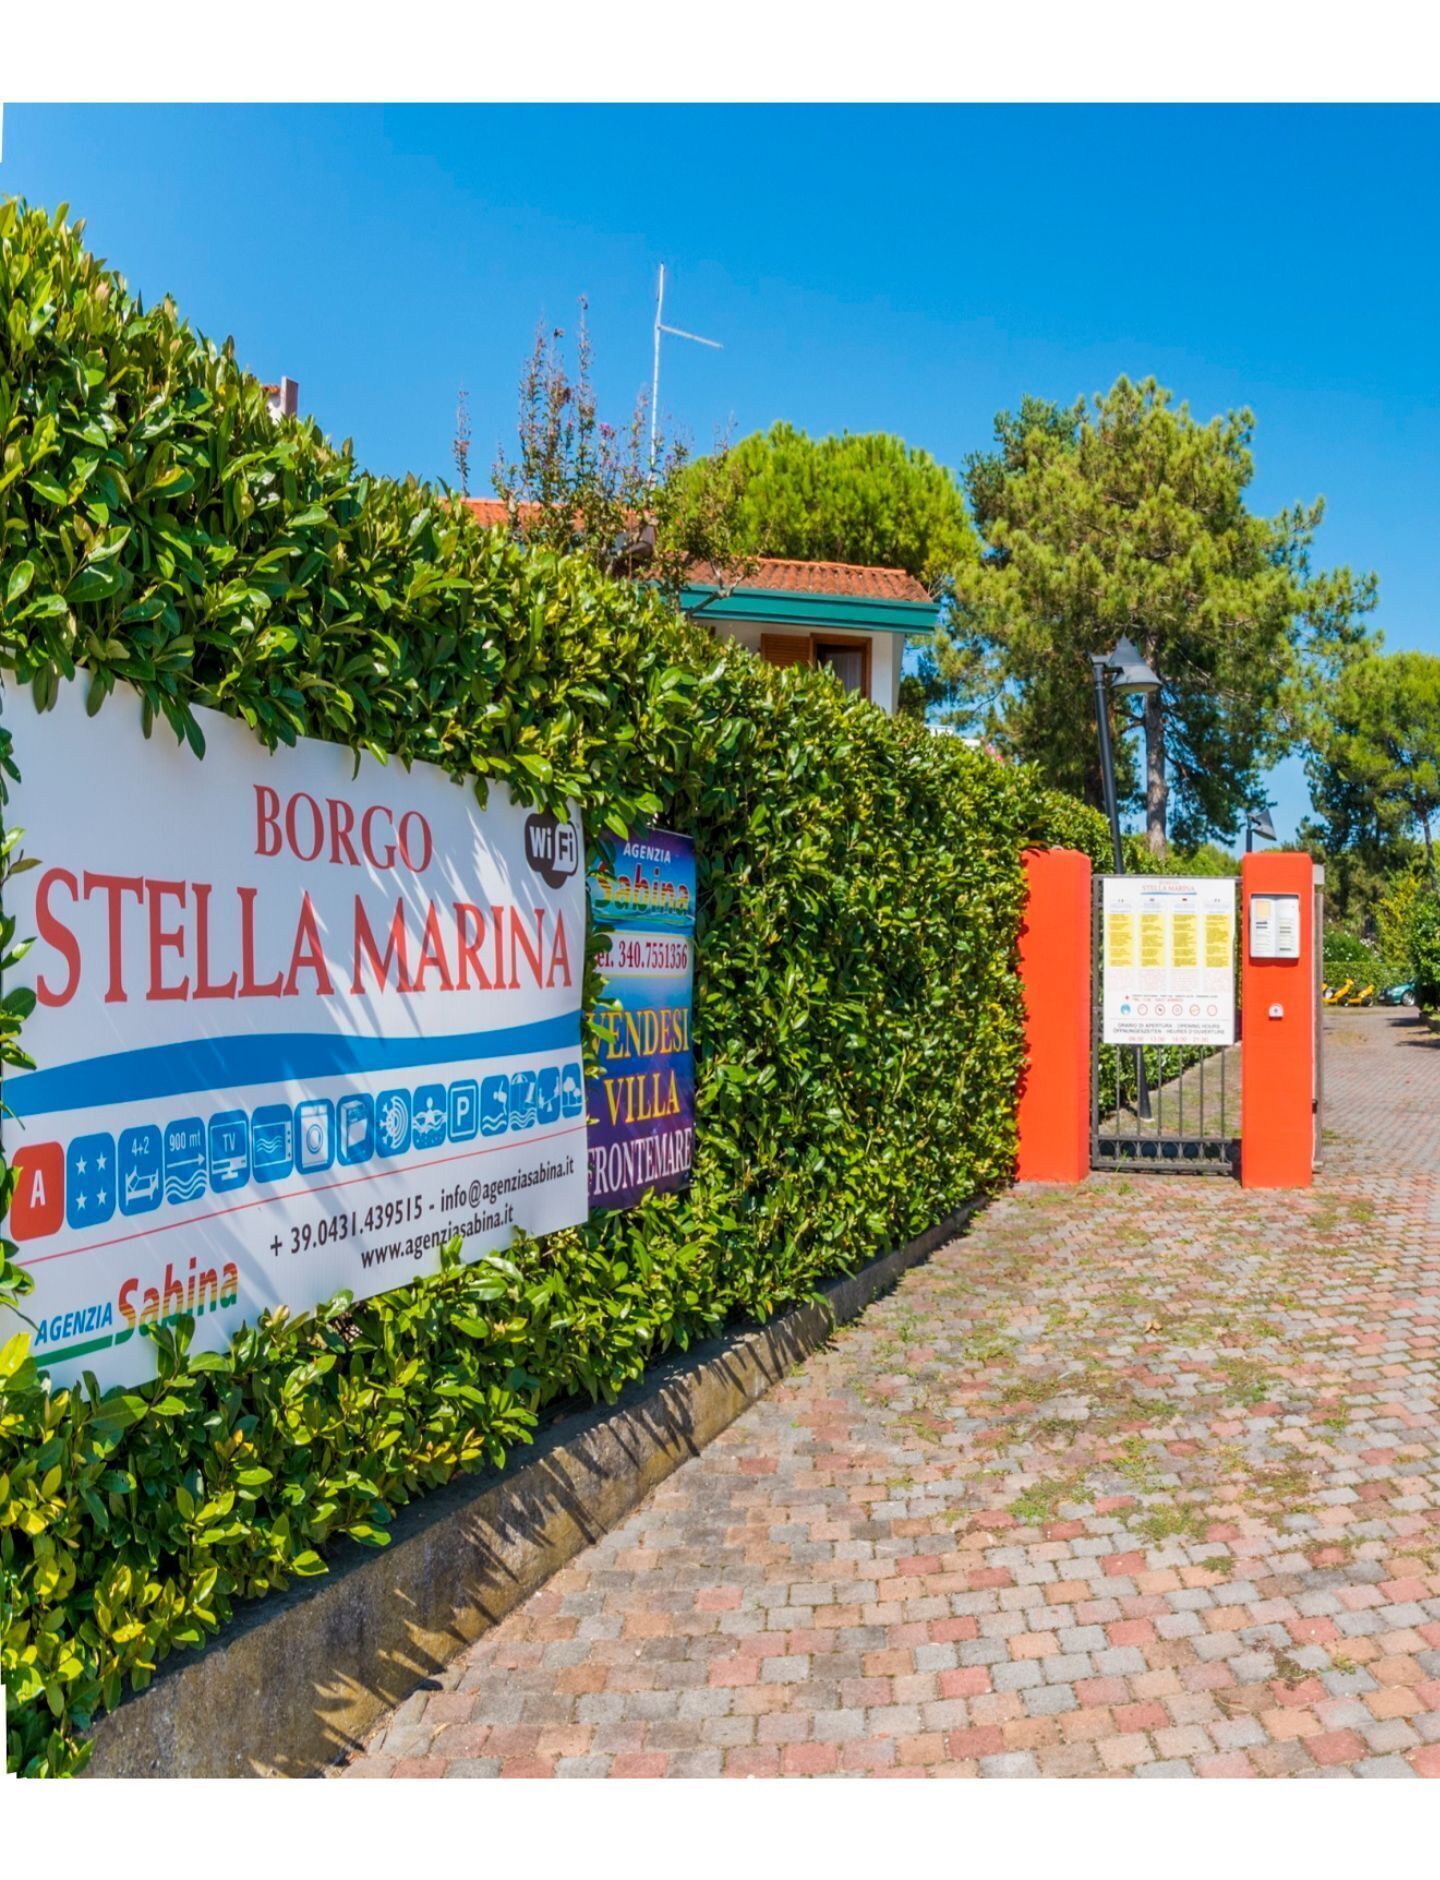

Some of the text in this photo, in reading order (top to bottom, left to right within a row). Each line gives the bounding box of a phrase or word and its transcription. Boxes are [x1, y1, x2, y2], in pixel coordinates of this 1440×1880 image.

[253, 783, 433, 874] BORGO
[623, 842, 672, 864] AGENZIA
[593, 860, 690, 916] Sabina
[35, 866, 573, 1008] STELLA MARINA
[618, 940, 688, 970] 340.7551356
[584, 1007, 691, 1061] VENDESI
[603, 1069, 681, 1127] VILLA
[131, 1135, 150, 1157] 4+2
[168, 1130, 187, 1152] 900
[222, 1132, 236, 1153] TV
[587, 1127, 693, 1197] FRONTEMARE
[30, 1168, 46, 1209] A
[290, 1194, 423, 1254] 39.0431.439515
[440, 1154, 575, 1213] info@agenziasabina.it
[360, 1202, 514, 1270] www.agenziasabina.it
[34, 1256, 239, 1346] AGENZIA Sabina
